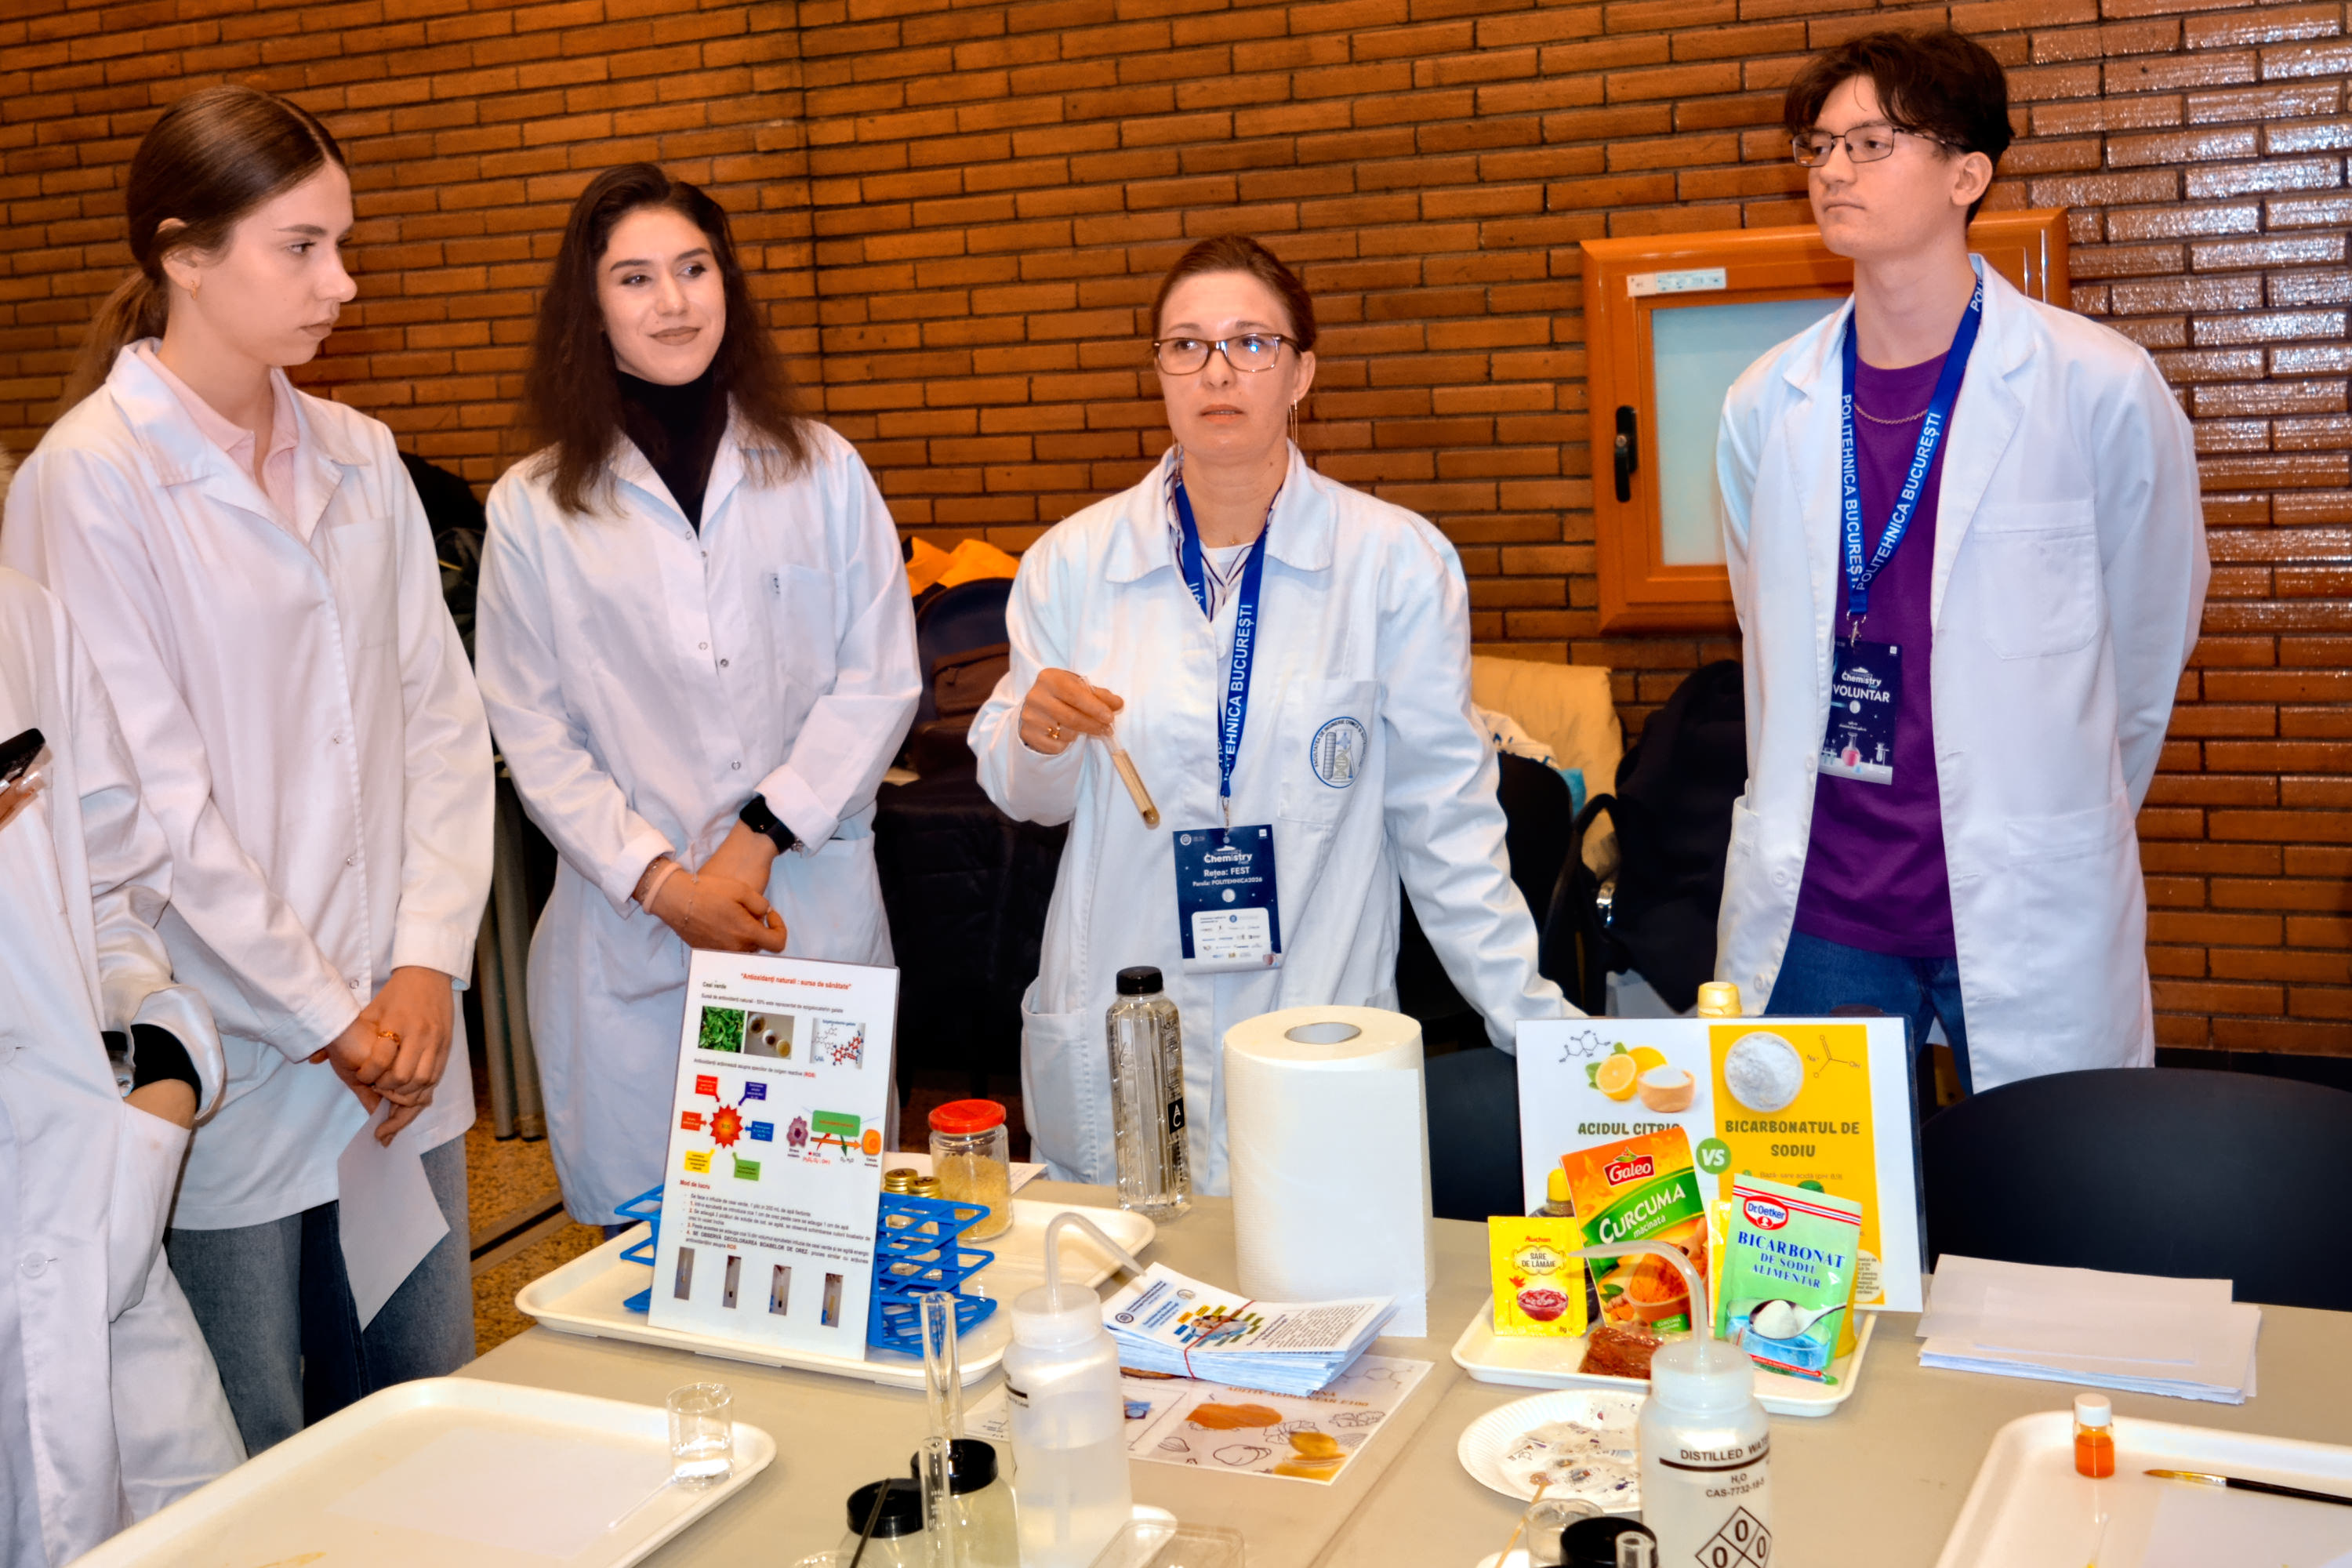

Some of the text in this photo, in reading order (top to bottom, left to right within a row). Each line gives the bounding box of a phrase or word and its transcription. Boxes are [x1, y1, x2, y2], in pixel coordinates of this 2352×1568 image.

[1842, 394, 1863, 588] POLITEHNICA BUCUREȘ
[1856, 412, 1941, 590] POLITEHNICA BUCUREȘTI
[1230, 604, 1254, 691] BUCUREȘTI
[1842, 670, 1882, 687] Chemistry
[1833, 684, 1890, 703] VOLUNTAR
[1203, 851, 1253, 863] Chemistry
[1230, 866, 1250, 875] FEST
[1578, 1123, 1629, 1134] ACIDUL
[1725, 1120, 1860, 1134] BICARBONATUL DE
[1702, 1149, 1725, 1167] VS
[1771, 1144, 1816, 1157] SODIU
[1610, 1162, 1652, 1182] Galeo
[1599, 1183, 1686, 1244] CURCUMA
[1738, 1231, 1845, 1269] BICARBONAT
[1760, 1253, 1816, 1275] DE SODIU
[1751, 1264, 1821, 1289] ALIMENTAR
[1680, 1449, 1743, 1461] DISTILLED
[1735, 1519, 1748, 1542] 0
[1712, 1546, 1728, 1568] 0
[1757, 1536, 1766, 1559] 0
